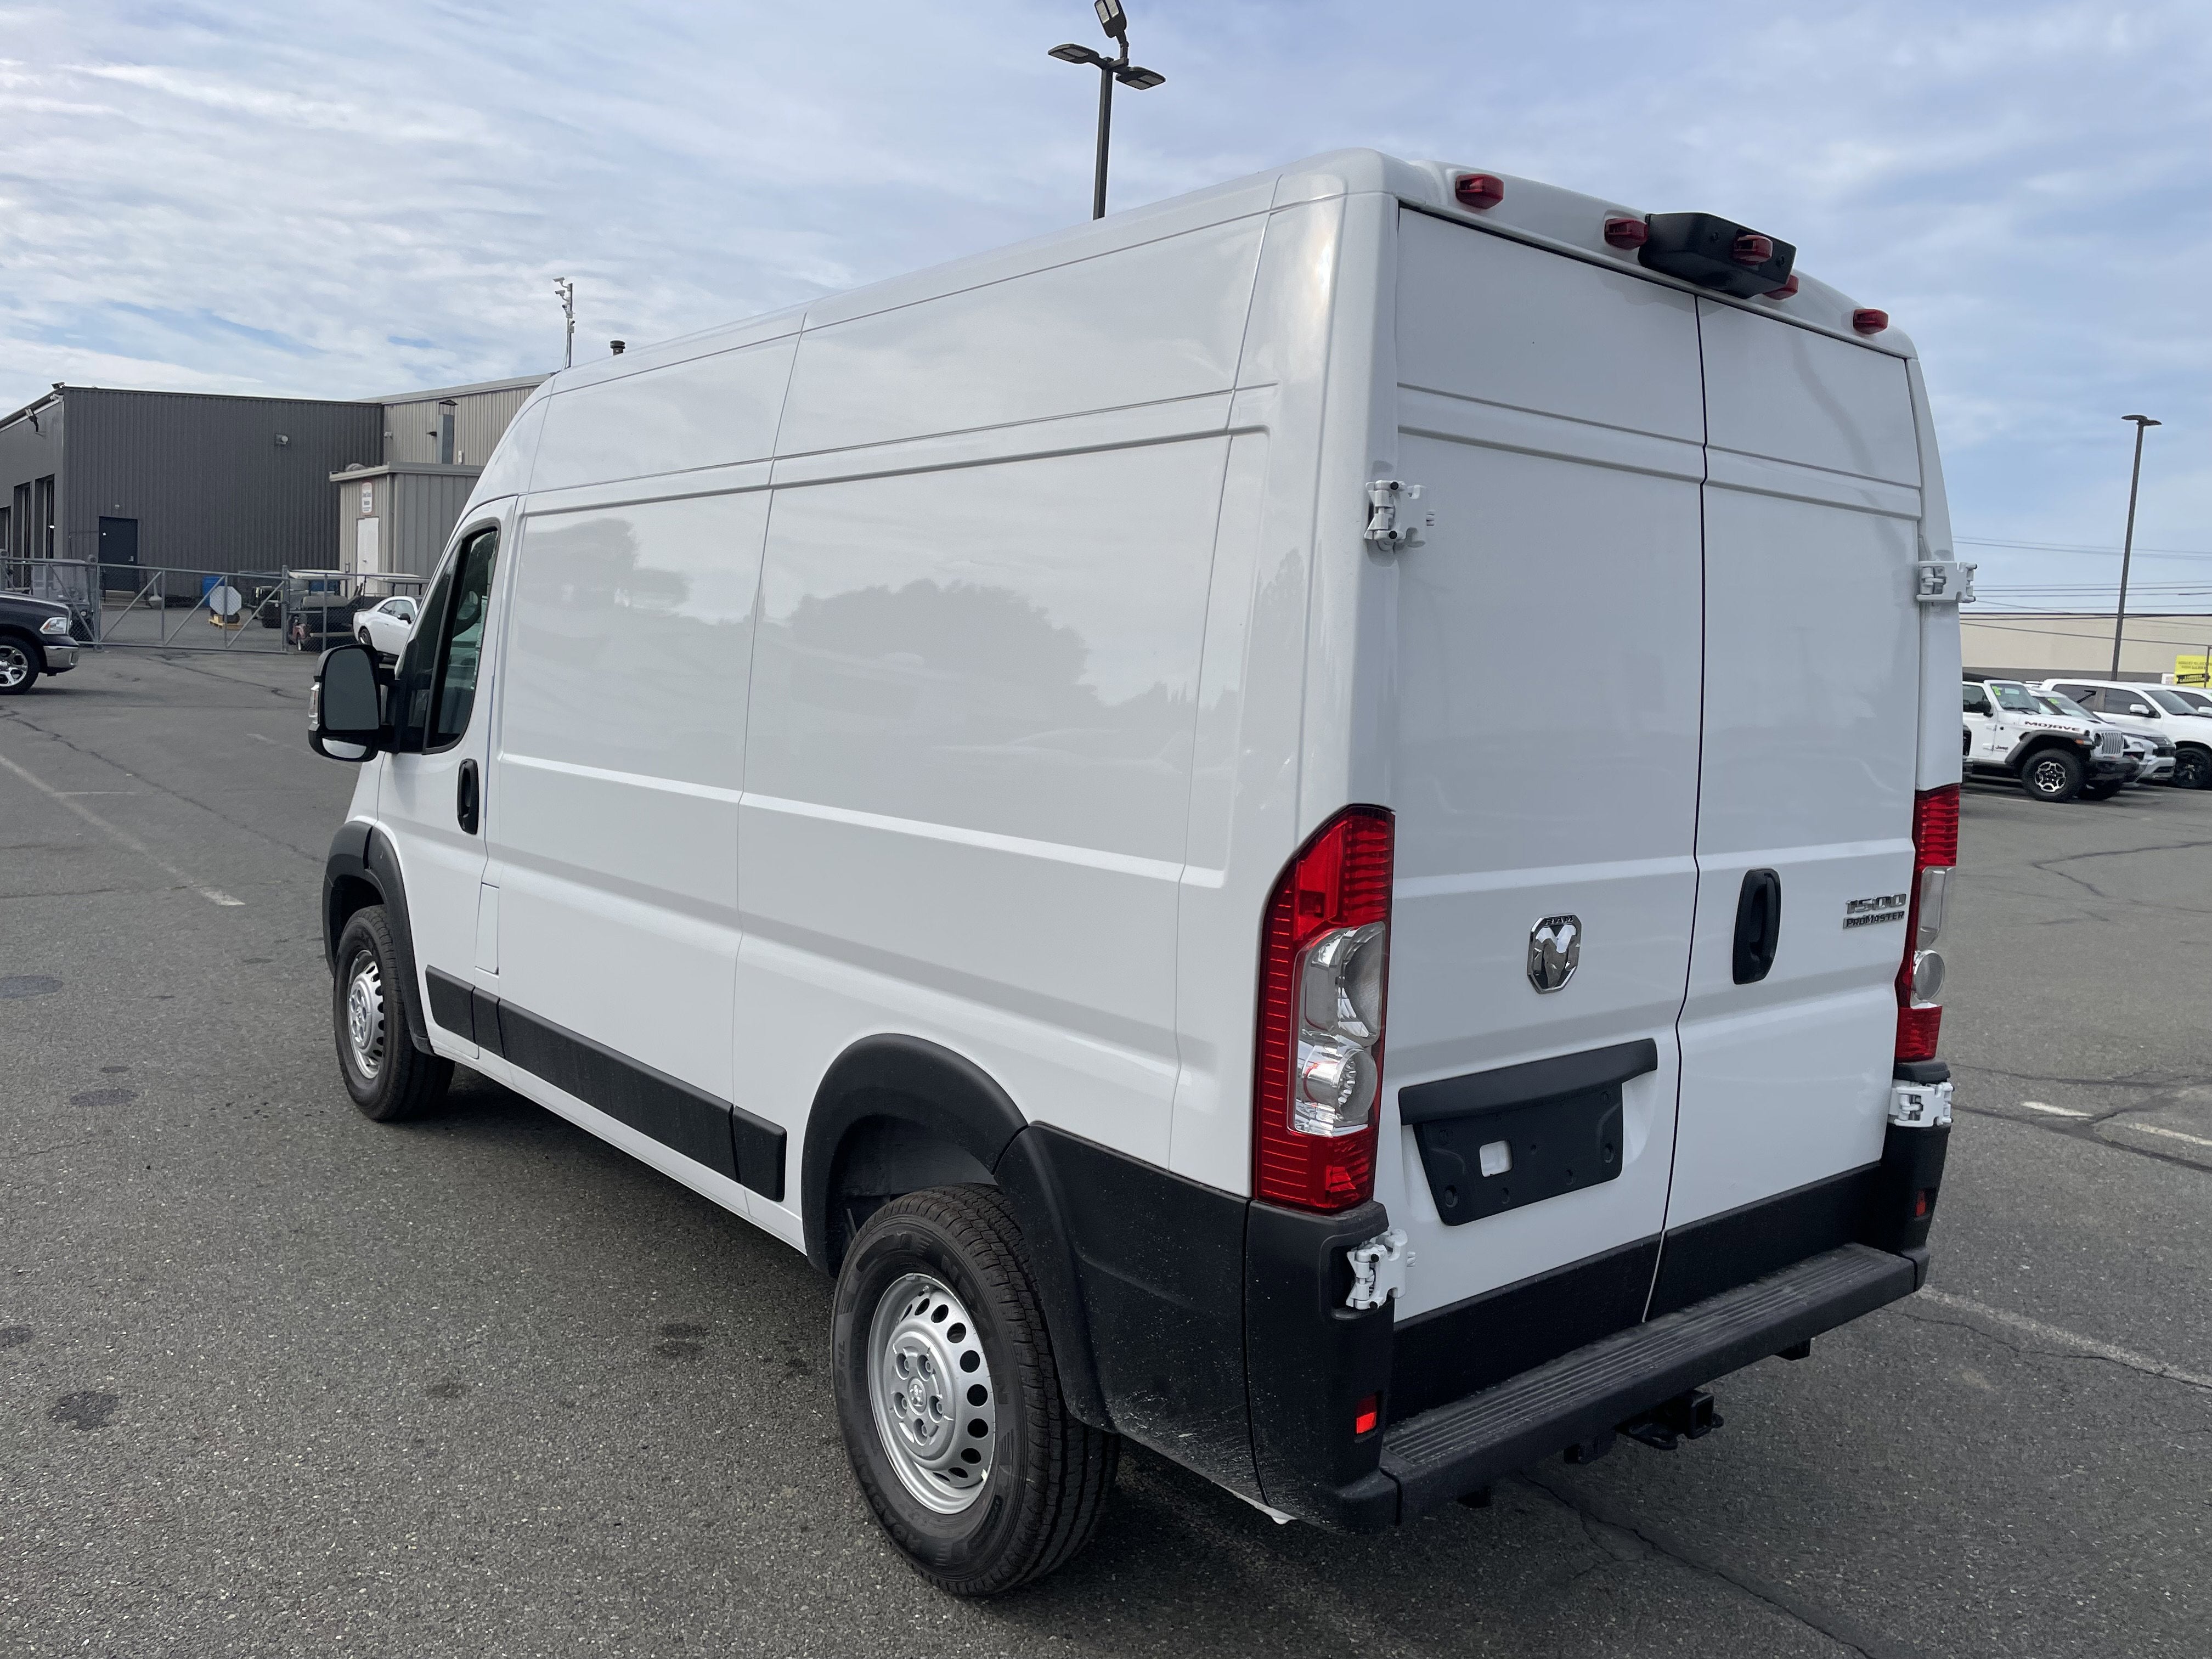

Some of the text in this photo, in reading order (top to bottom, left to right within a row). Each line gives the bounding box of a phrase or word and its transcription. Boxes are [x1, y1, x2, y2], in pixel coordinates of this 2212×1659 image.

[2024, 721, 2080, 732] MOJAVE
[1846, 893, 1906, 915] 1500
[1545, 916, 1573, 926] RAM
